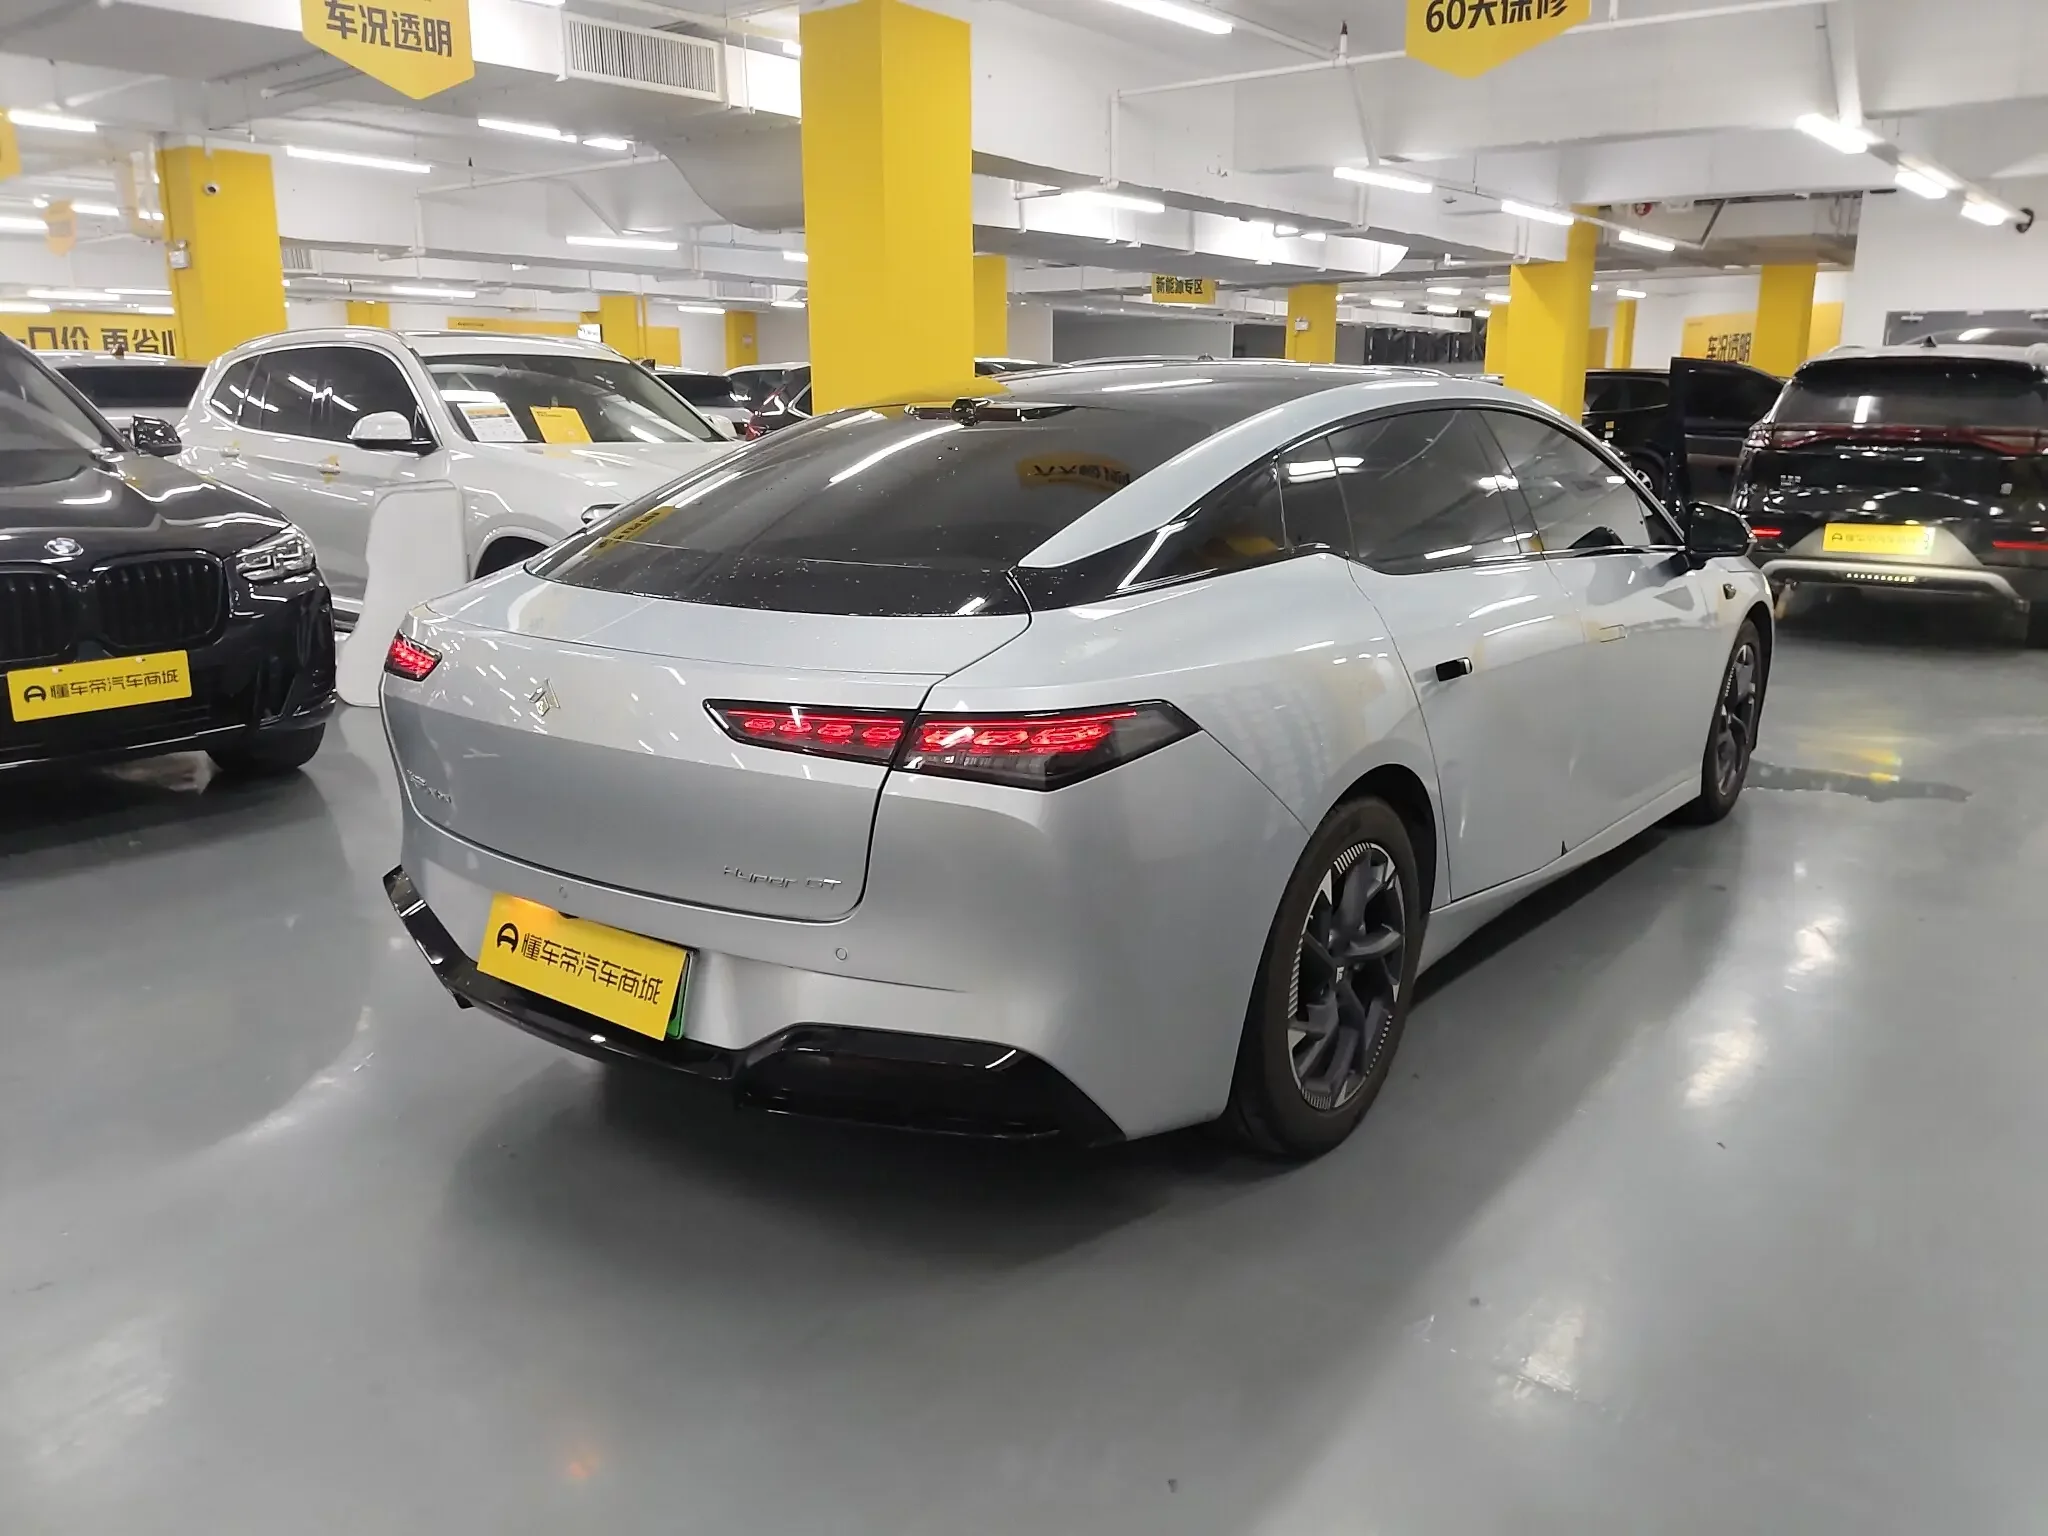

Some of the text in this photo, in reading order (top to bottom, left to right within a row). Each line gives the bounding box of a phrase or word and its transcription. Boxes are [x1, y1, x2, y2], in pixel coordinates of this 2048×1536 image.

[325, 0, 452, 57] 车况透明
[51, 669, 179, 699] 懂车帝汽车商城
[521, 933, 664, 1004] 懂车帝汽车商城
